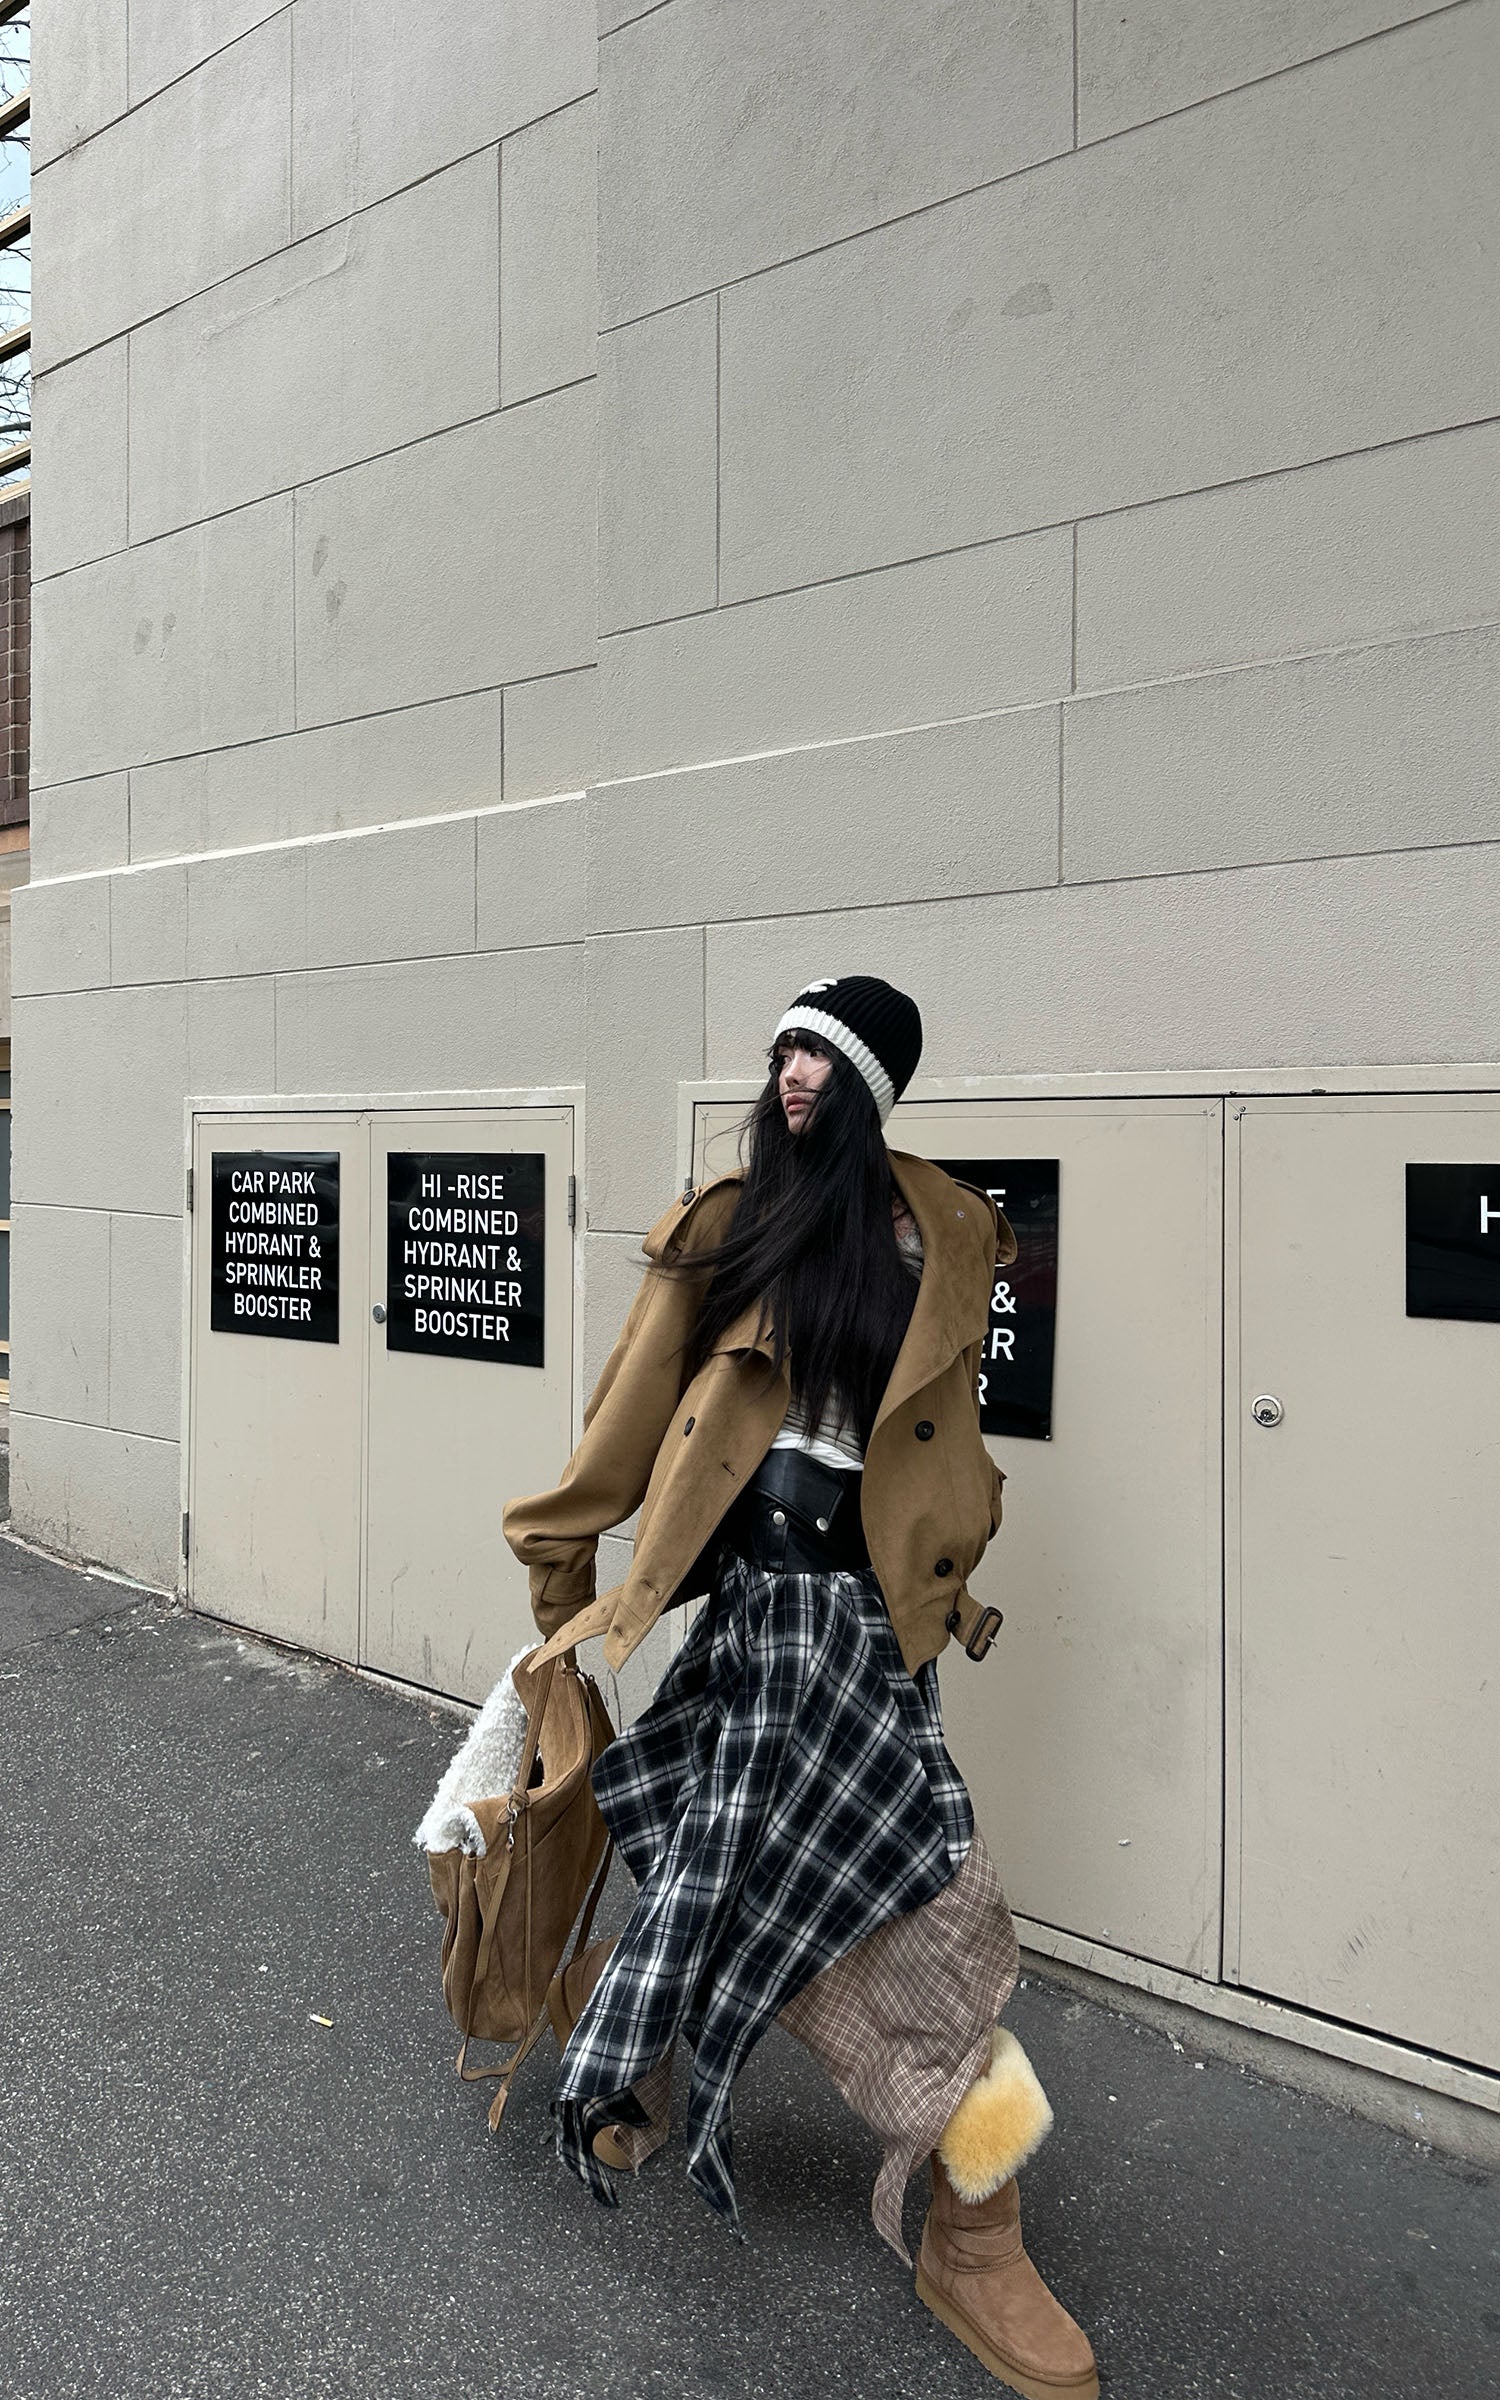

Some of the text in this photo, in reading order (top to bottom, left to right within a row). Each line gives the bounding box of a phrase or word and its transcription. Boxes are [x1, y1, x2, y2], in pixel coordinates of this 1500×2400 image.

[231, 1170, 316, 1195] CAR PARK
[421, 1173, 441, 1198] HI
[229, 1201, 319, 1226] COMBINED
[408, 1206, 518, 1236] COMBINED
[225, 1231, 322, 1259] HYDRANT &
[404, 1240, 522, 1272] HYDRANT &
[225, 1261, 322, 1291] SPRINKLER
[404, 1273, 522, 1308] SPRINKLER
[234, 1292, 312, 1322] BOOSTER
[990, 1281, 1017, 1314] &
[414, 1308, 510, 1342] BOOSTER
